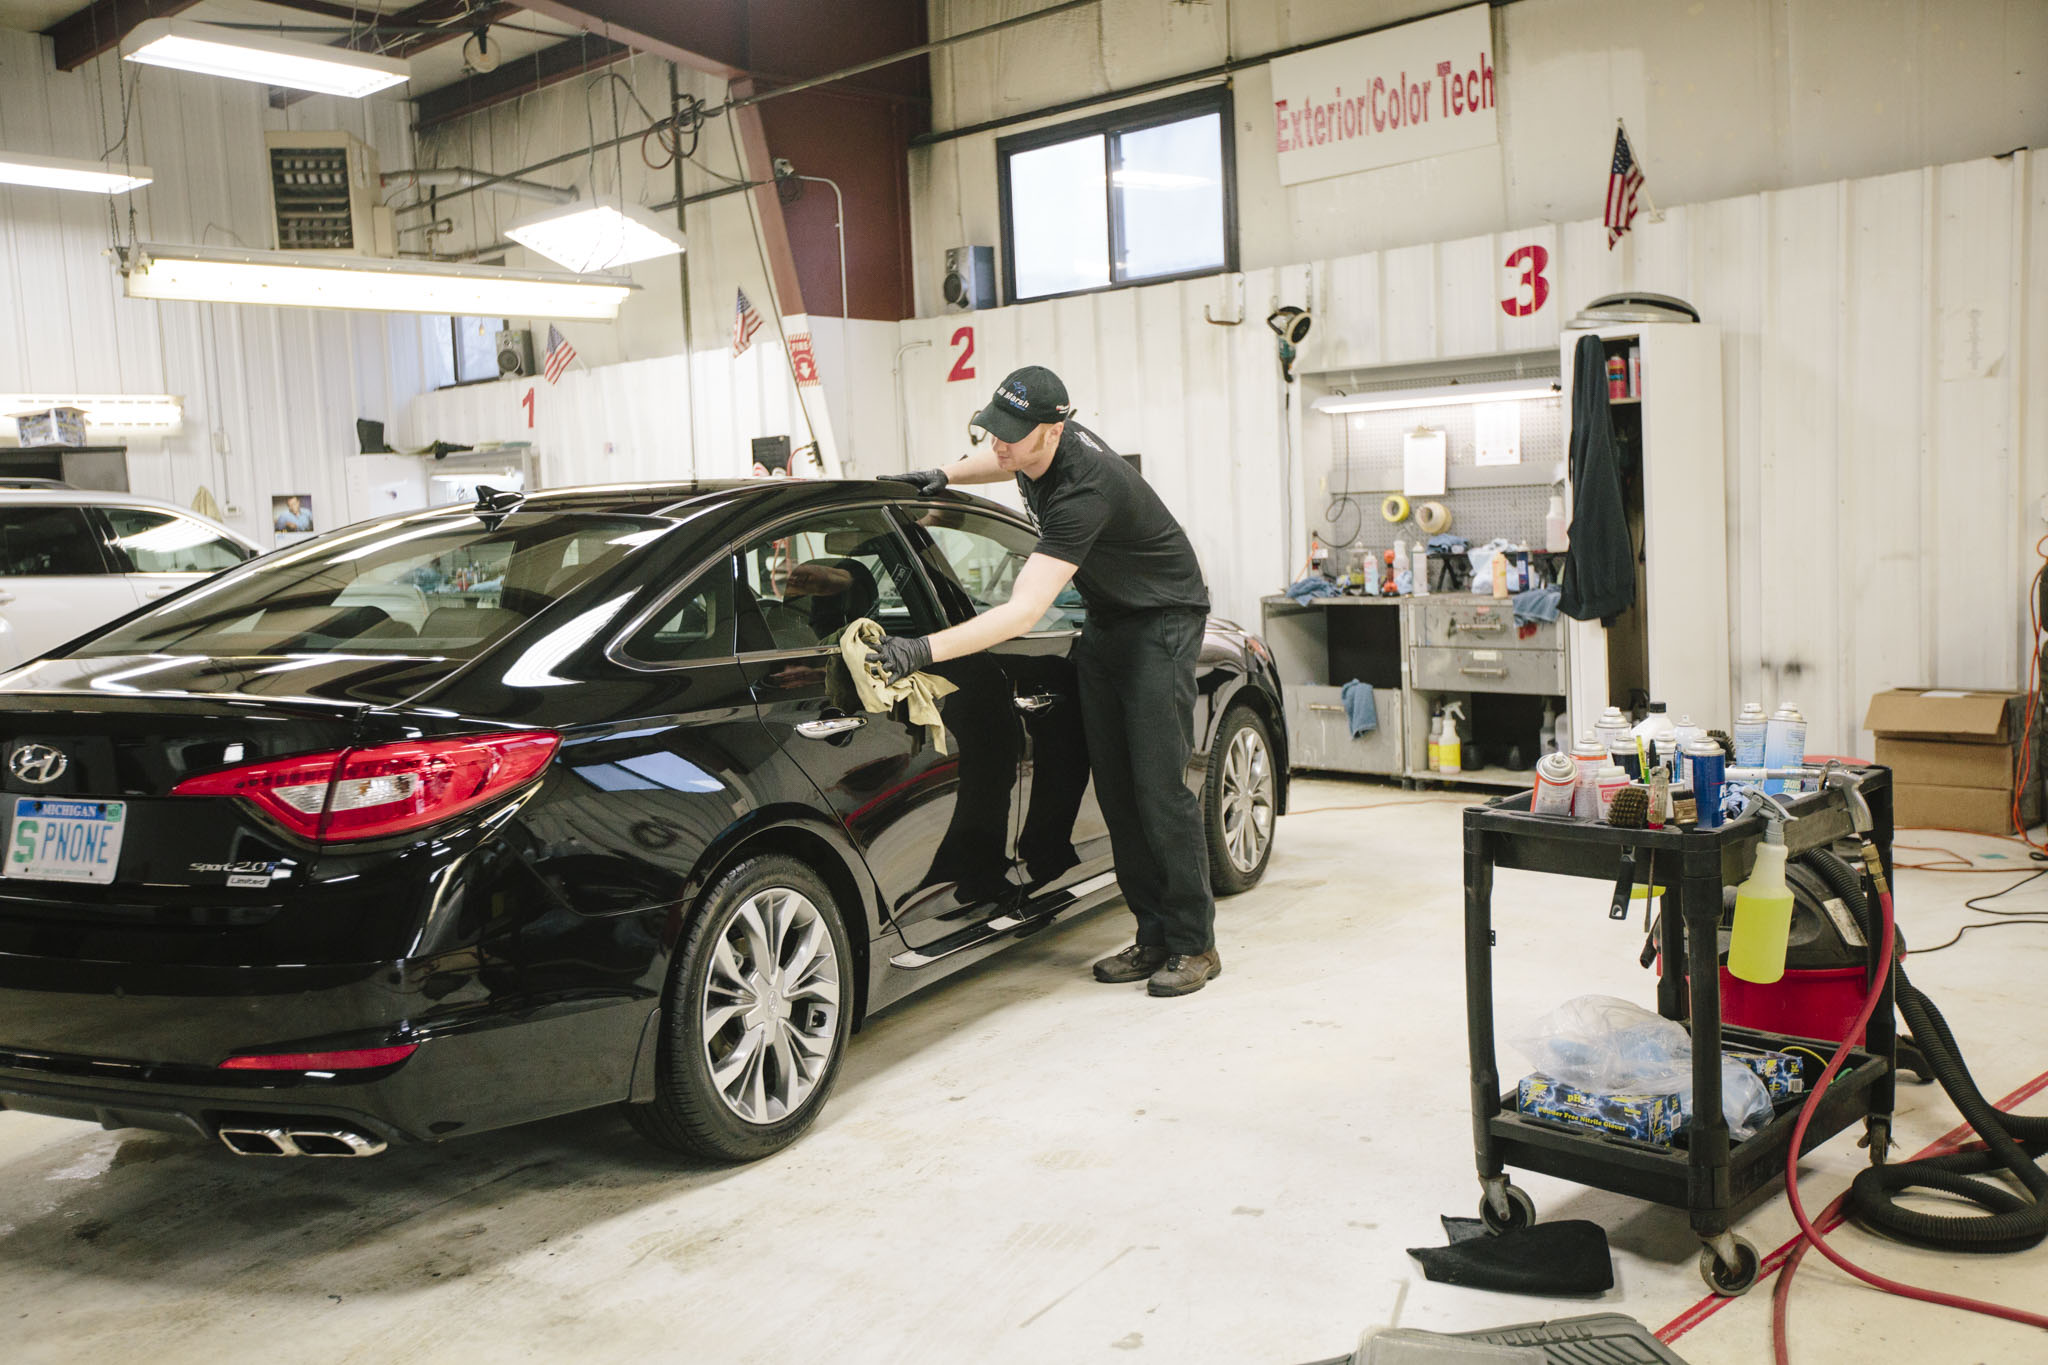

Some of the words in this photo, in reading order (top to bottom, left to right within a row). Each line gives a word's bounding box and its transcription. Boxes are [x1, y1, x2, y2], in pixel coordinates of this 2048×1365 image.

[1275, 71, 1432, 153] Exterior/Color
[1436, 52, 1495, 118] Tech
[1500, 245, 1550, 317] 3
[947, 326, 976, 382] 2
[522, 387, 535, 429] 1
[1004, 391, 1030, 409] Marsh
[41, 803, 97, 817] MICHIGAN
[230, 877, 265, 885] Limited
[1538, 1106, 1563, 1118] Powder
[1564, 1112, 1579, 1121] Free
[1580, 1115, 1602, 1126] Nitrile
[1603, 1120, 1626, 1132] Gloves
